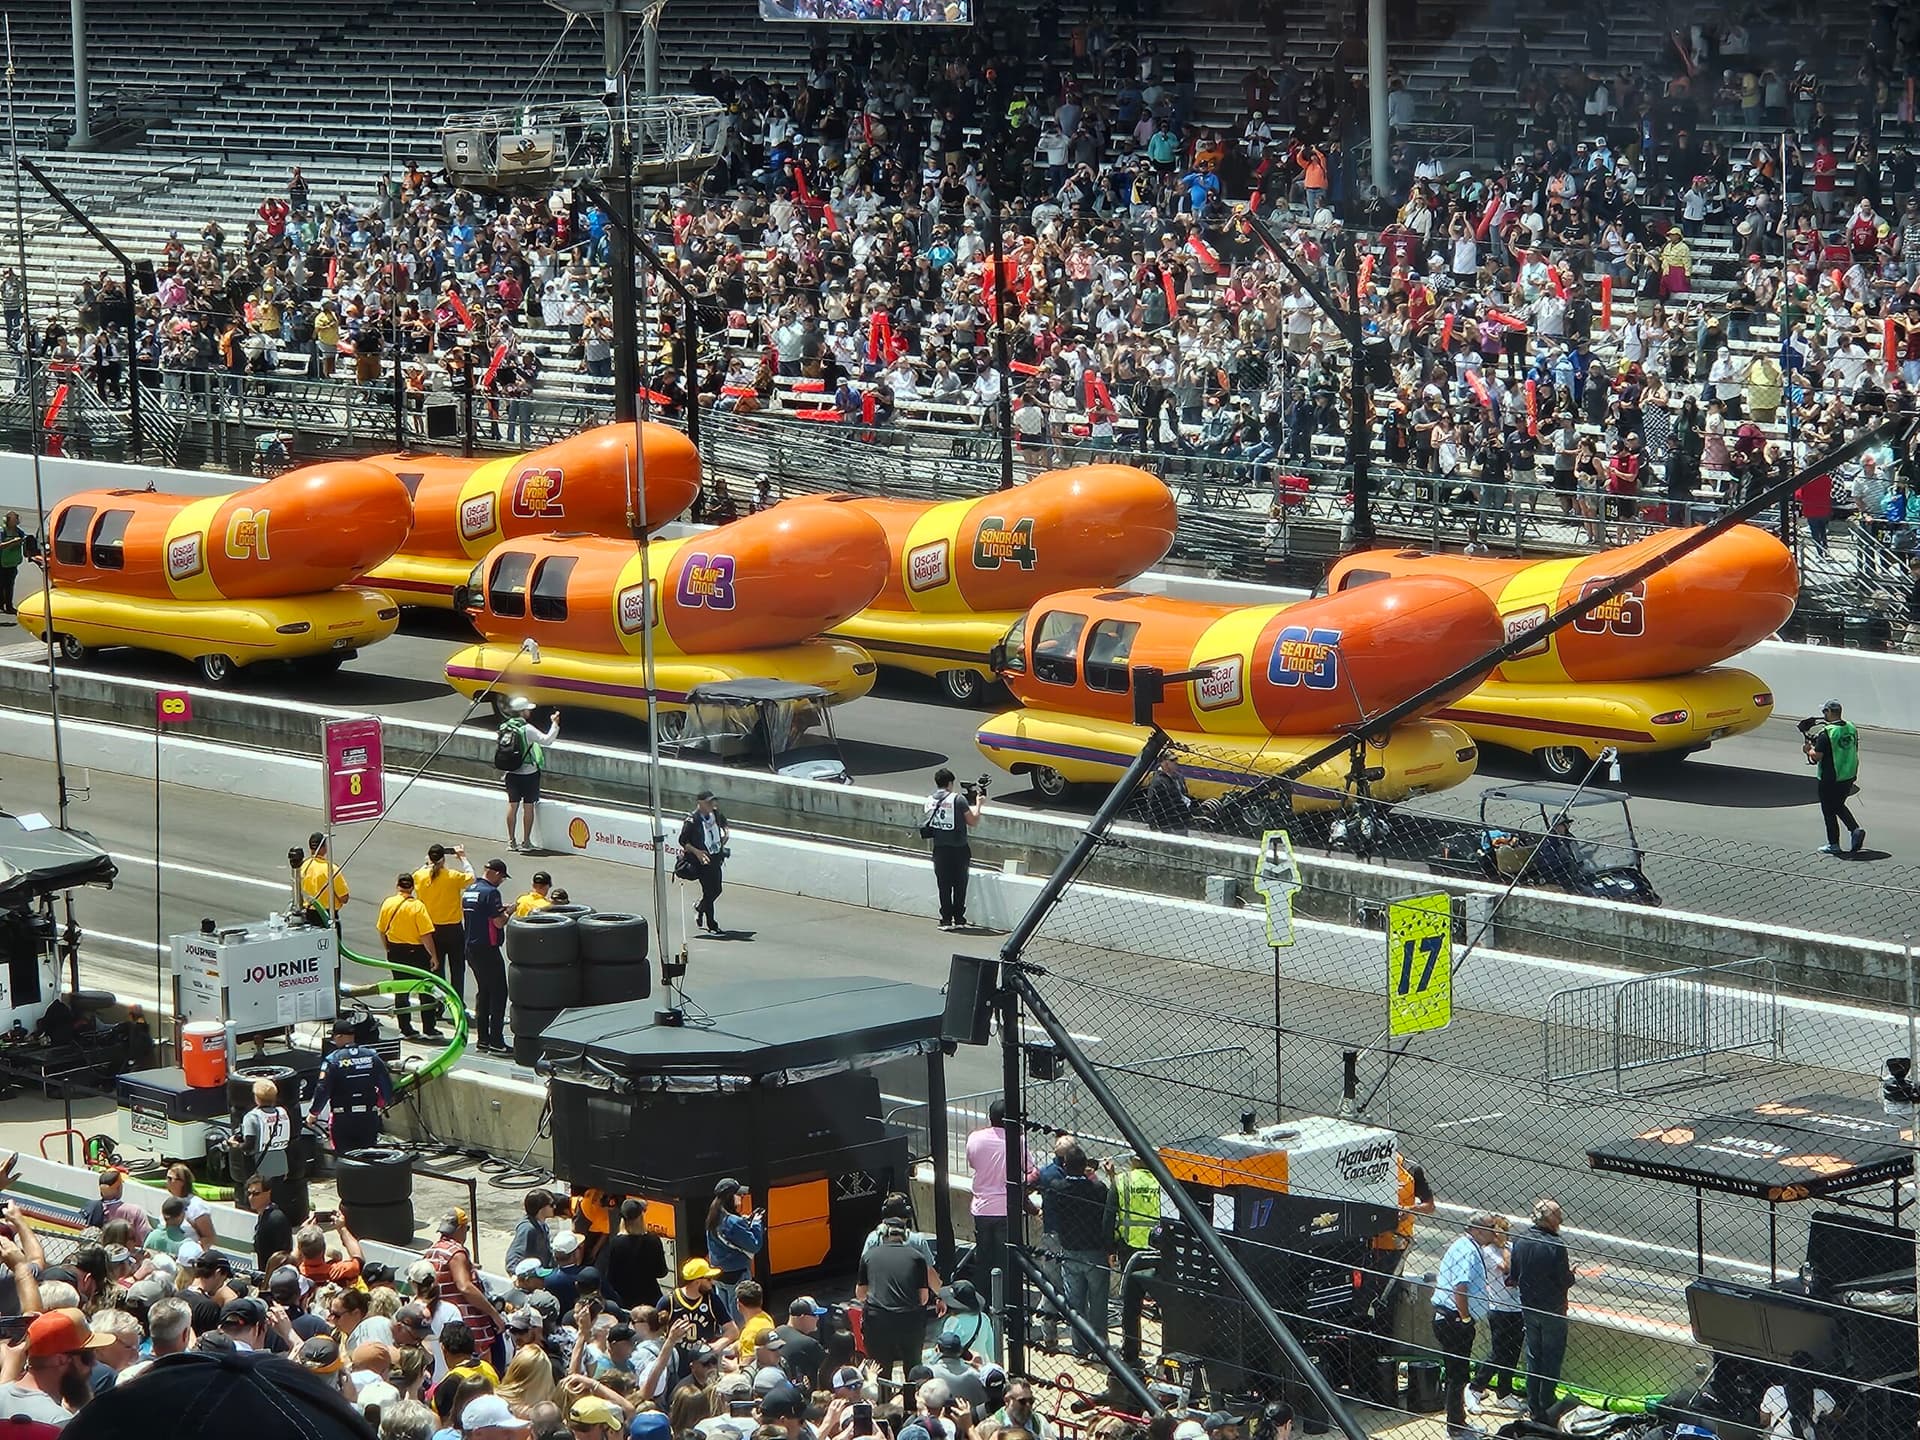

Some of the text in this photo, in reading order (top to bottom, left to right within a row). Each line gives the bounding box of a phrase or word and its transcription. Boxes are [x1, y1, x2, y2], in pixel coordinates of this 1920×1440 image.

[530, 475, 550, 487] NEW
[526, 487, 549, 499] YORK
[467, 501, 489, 517] Oscar
[529, 499, 548, 510] DOG
[466, 512, 489, 529] Mayer
[980, 530, 1027, 545] SONORAN
[992, 544, 1012, 557] DOG
[914, 550, 941, 568] Oscar
[692, 567, 719, 582] SLAW
[914, 561, 941, 580] Mayer
[695, 581, 714, 595] DOG
[1596, 605, 1620, 620] DOG
[1508, 615, 1542, 635] Oscar
[1280, 640, 1328, 661] SEATTLE
[1290, 657, 1314, 673] DOG
[1202, 680, 1234, 699] Mayer
[350, 773, 361, 795] 8
[595, 832, 615, 844] Shell
[243, 957, 319, 983] JOURNIE
[1397, 932, 1446, 995] 17
[279, 975, 319, 989] REWARDS
[1335, 1140, 1395, 1173] Hendrick
[1249, 1197, 1273, 1229] 17
